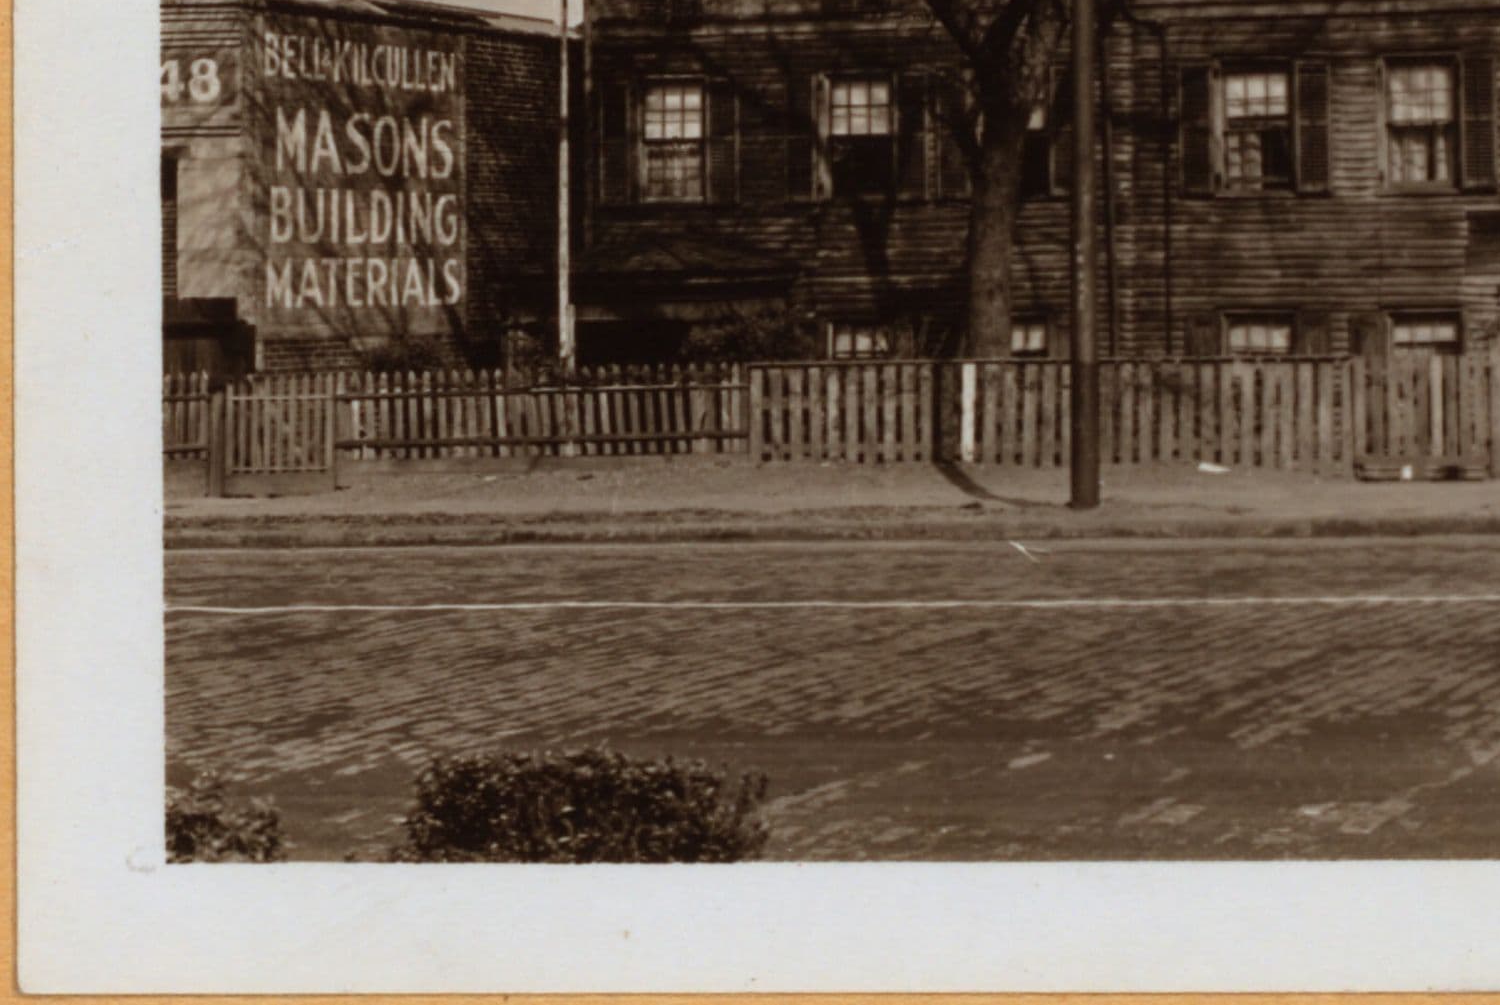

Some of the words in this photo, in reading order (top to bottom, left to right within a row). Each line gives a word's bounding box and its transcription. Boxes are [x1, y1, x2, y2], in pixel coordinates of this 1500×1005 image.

[263, 32, 326, 81] BELL
[333, 39, 456, 92] KILCULLEN
[276, 106, 453, 179] MASONS
[270, 185, 458, 246] BUILDING
[265, 258, 461, 309] MATERIALS
